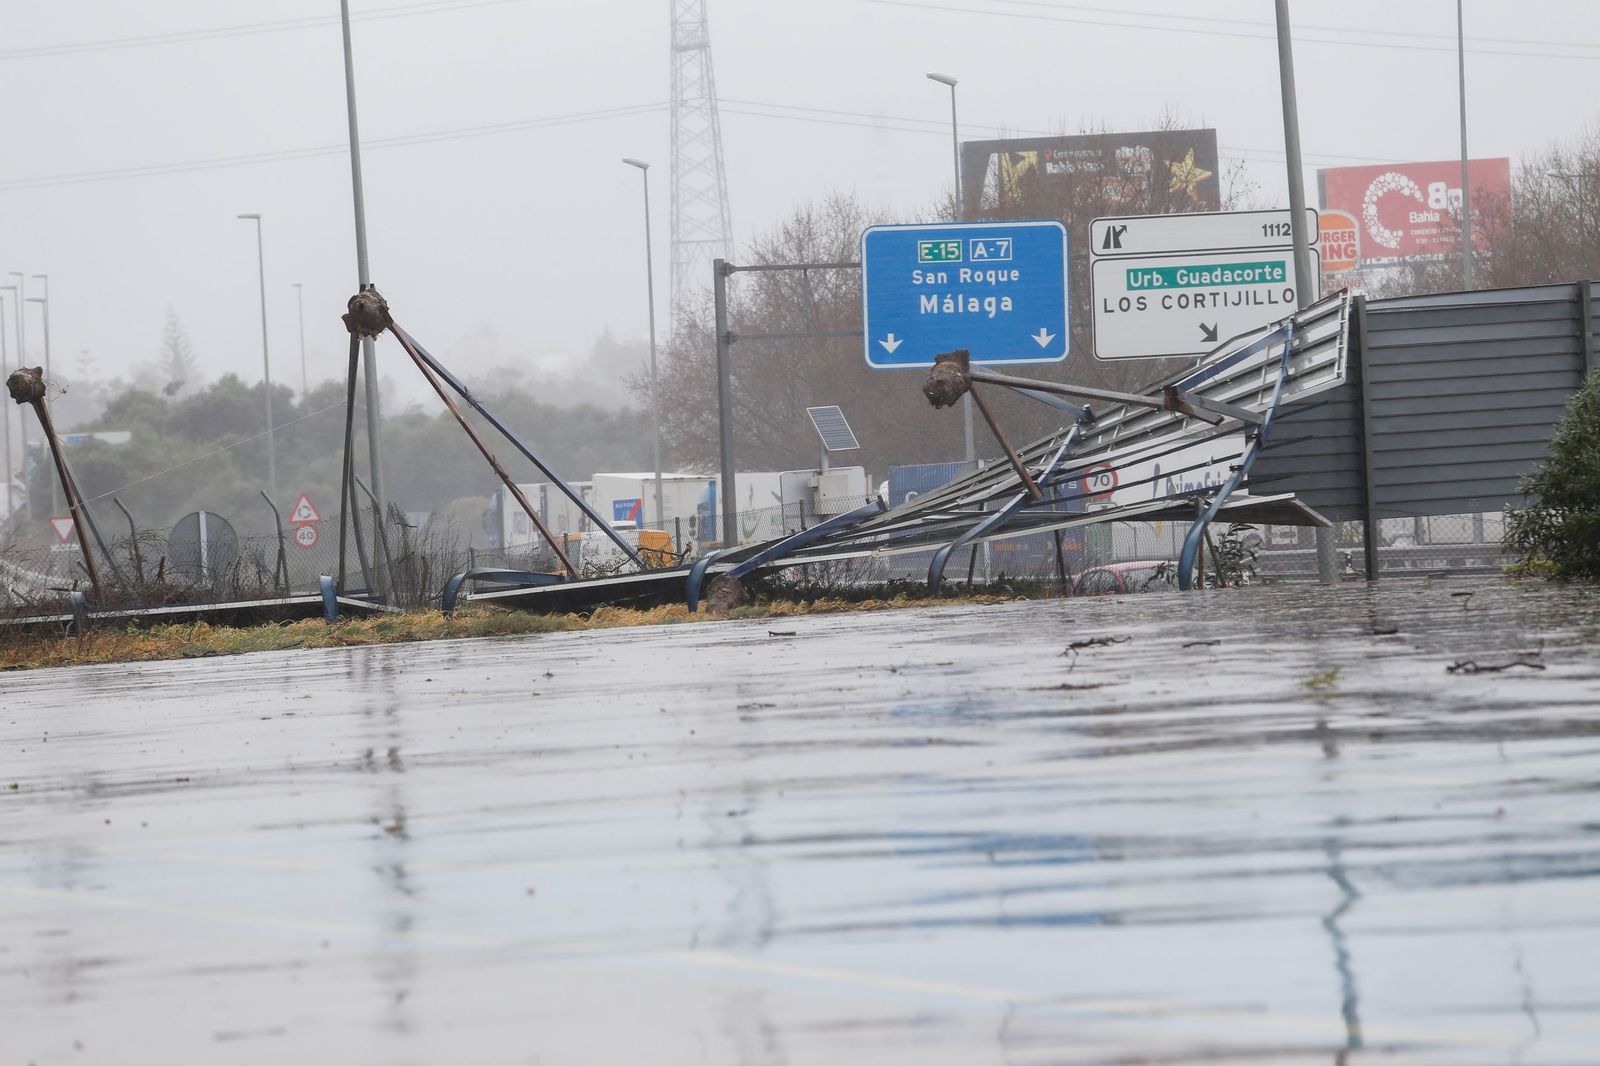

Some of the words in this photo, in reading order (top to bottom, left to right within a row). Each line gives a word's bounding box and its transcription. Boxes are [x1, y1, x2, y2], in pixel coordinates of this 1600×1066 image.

[1262, 223, 1291, 237] 1112
[1320, 231, 1356, 243] RGER
[921, 242, 959, 259] E-15
[973, 241, 1009, 258] A-7
[1322, 243, 1357, 260] ING
[912, 269, 947, 284] San
[959, 268, 1020, 286] Roque
[1130, 270, 1168, 288] Urb.
[1176, 264, 1283, 286] Guadacorte
[920, 294, 1013, 319] Málaga
[1103, 296, 1148, 314] LOS
[1161, 287, 1295, 310] CORTIJILLO
[1091, 474, 1110, 487] 70
